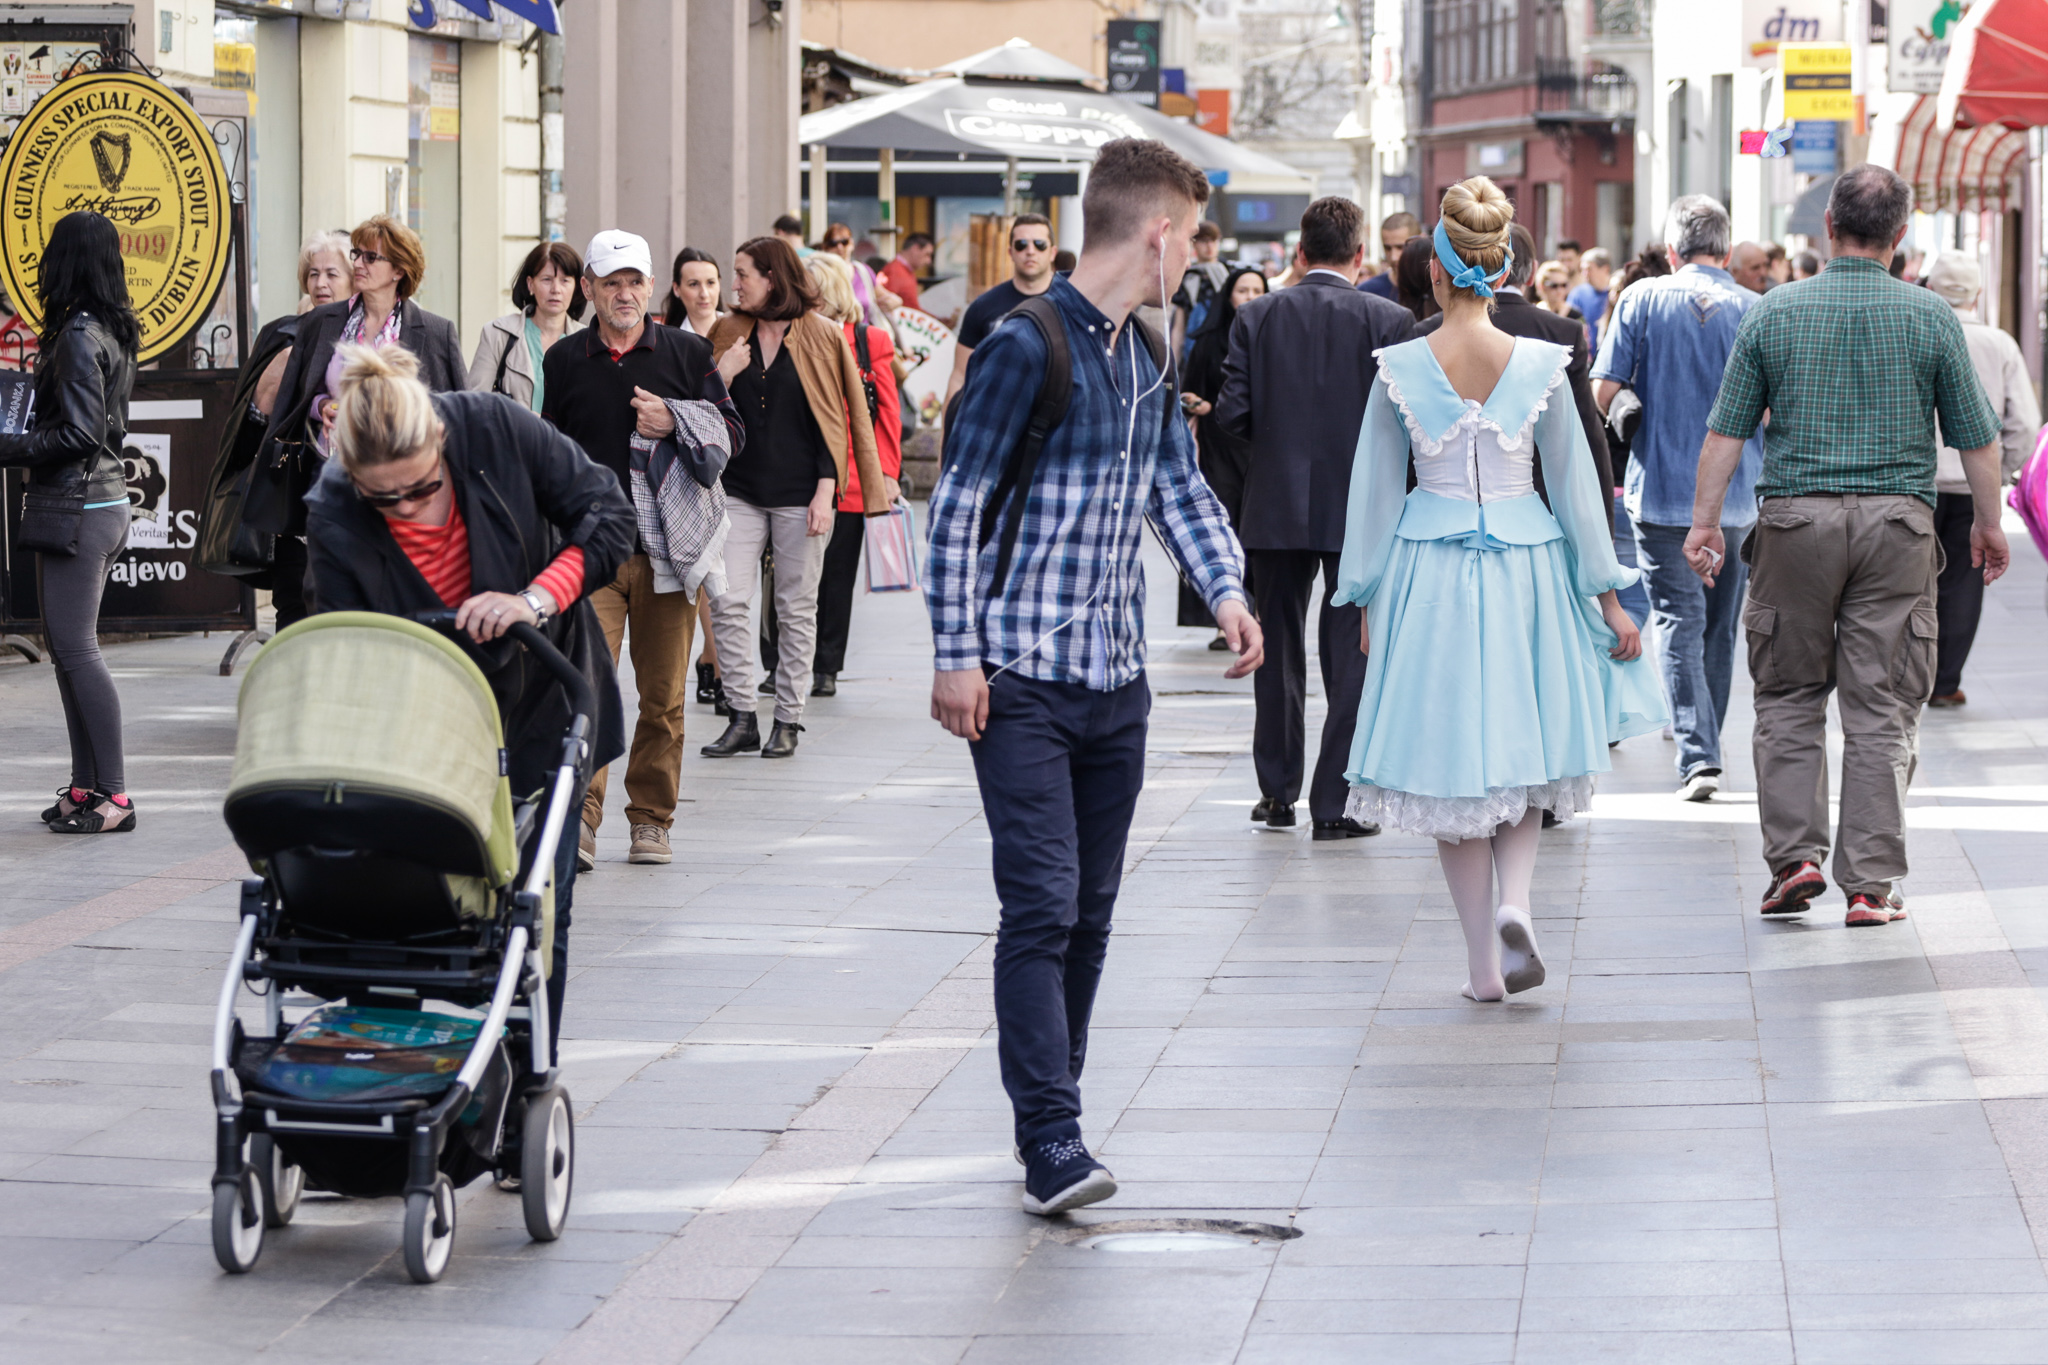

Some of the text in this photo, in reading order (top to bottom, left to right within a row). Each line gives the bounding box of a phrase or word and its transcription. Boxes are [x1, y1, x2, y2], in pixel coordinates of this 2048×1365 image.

[1764, 7, 1820, 39] dm
[63, 130, 90, 155] GUINNESS
[89, 124, 103, 133] SON
[110, 121, 141, 135] COMPANY
[14, 91, 209, 229] GUINNESS SPECIAL EXPORT STOUT
[63, 183, 99, 191] REGISTERED
[148, 255, 201, 327] DUBLIN
[131, 526, 168, 539] Veritas
